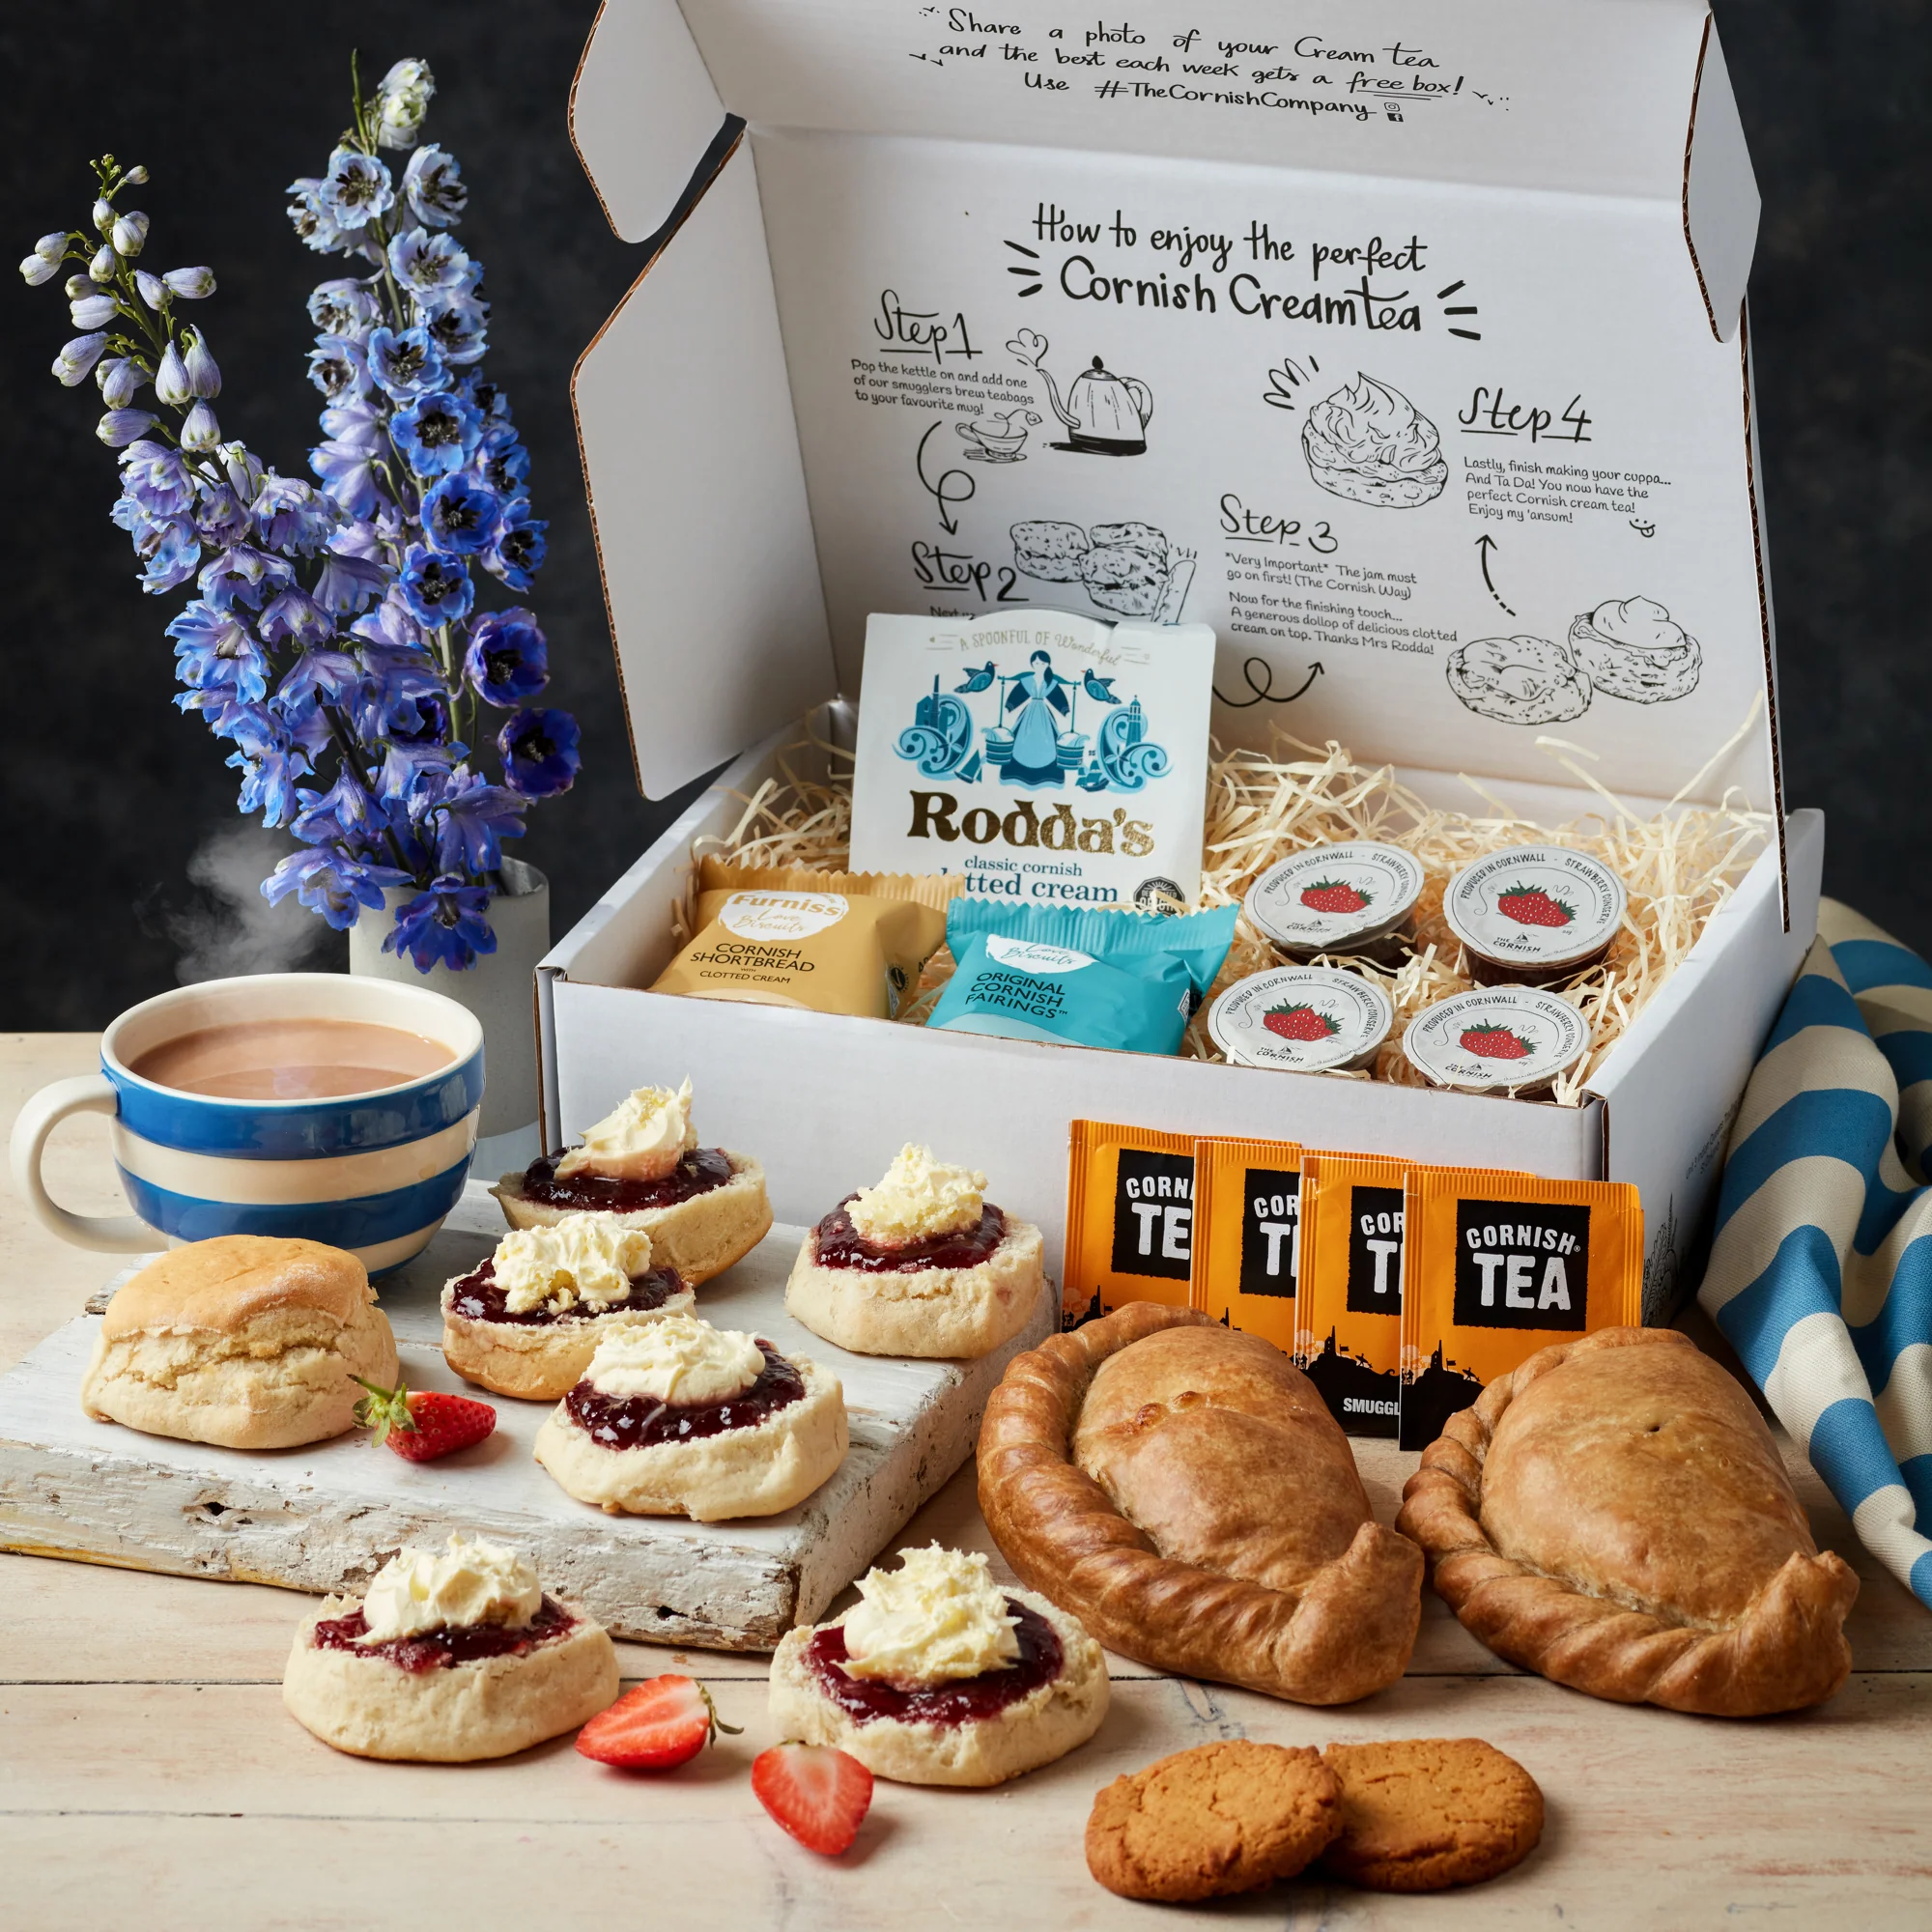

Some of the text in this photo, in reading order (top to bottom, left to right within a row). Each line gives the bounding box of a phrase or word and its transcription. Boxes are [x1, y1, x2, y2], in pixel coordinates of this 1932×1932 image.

[949, 8, 1439, 68] Share a photo of your Cream tea
[939, 43, 1464, 96] and the best each week gets a free box!
[1025, 71, 1378, 122] Use #TheCornishCompany
[1032, 202, 1428, 282] How to enjoy the perfect
[1060, 255, 1216, 314] Cornish
[851, 358, 1028, 388] Pop the kettle on and add one
[854, 374, 1035, 406] of our smugglers brew teabags
[855, 389, 984, 416] to your favourite mug!
[1459, 386, 1592, 443] Step 4
[1464, 456, 1671, 486] Lastly, finish making your cuppa...
[1465, 472, 1649, 498] And Ta Da! You now have the
[1467, 489, 1635, 513] perfect Cornish cream tea!
[1468, 503, 1573, 524] Enjoy my 'ansum!
[1220, 494, 1338, 554] Step 3
[911, 541, 1030, 602] Step 2
[1227, 570, 1411, 601] go on first! (The Cornish Way)
[1335, 564, 1360, 578] The
[1362, 567, 1384, 582] jam
[1387, 573, 1417, 583] must
[1229, 591, 1403, 621] Now for the finishing touch...
[1231, 606, 1458, 641] A generous dollop of delicious clotted
[959, 630, 1122, 666] A SPOONFUL OF Wonderful
[1231, 623, 1435, 655] cream on top. Thanks Mrs Rodda!
[907, 790, 1154, 857] Rodda's
[964, 855, 1082, 876] classic cornish
[1264, 868, 1294, 895] PRODUCED
[1294, 862, 1305, 871] IN
[1305, 851, 1354, 867] CORNWALL
[1461, 869, 1487, 899] PRODUCED
[1487, 864, 1496, 873] IN
[1496, 853, 1546, 868] CORNWALL
[1565, 858, 1609, 893] STRAWBERRY
[1032, 879, 1118, 902] cream
[731, 895, 840, 917] Furniss
[757, 908, 801, 923] Love
[716, 943, 802, 959] CORNISH
[1492, 940, 1541, 953] CORNISH
[690, 952, 815, 972] SHORTBREAD
[699, 970, 790, 983] CLOTTED CREAM
[970, 982, 1063, 1008] CORNISH
[976, 972, 1065, 996] ORIGINAL
[1226, 989, 1253, 1015] PRODUCED
[1252, 984, 1263, 993] IN
[1264, 974, 1313, 989] CORNWALL
[1422, 1008, 1454, 1034] PRODUCED
[1455, 1003, 1465, 1012] IN
[1466, 995, 1518, 1008] CORNWALL
[1535, 1001, 1575, 1032] STRAWBERRY
[1125, 1176, 1194, 1200] CORN
[1131, 1202, 1192, 1261] TE
[1472, 1252, 1572, 1311] TEA
[1343, 1397, 1400, 1416] SMUGGL
